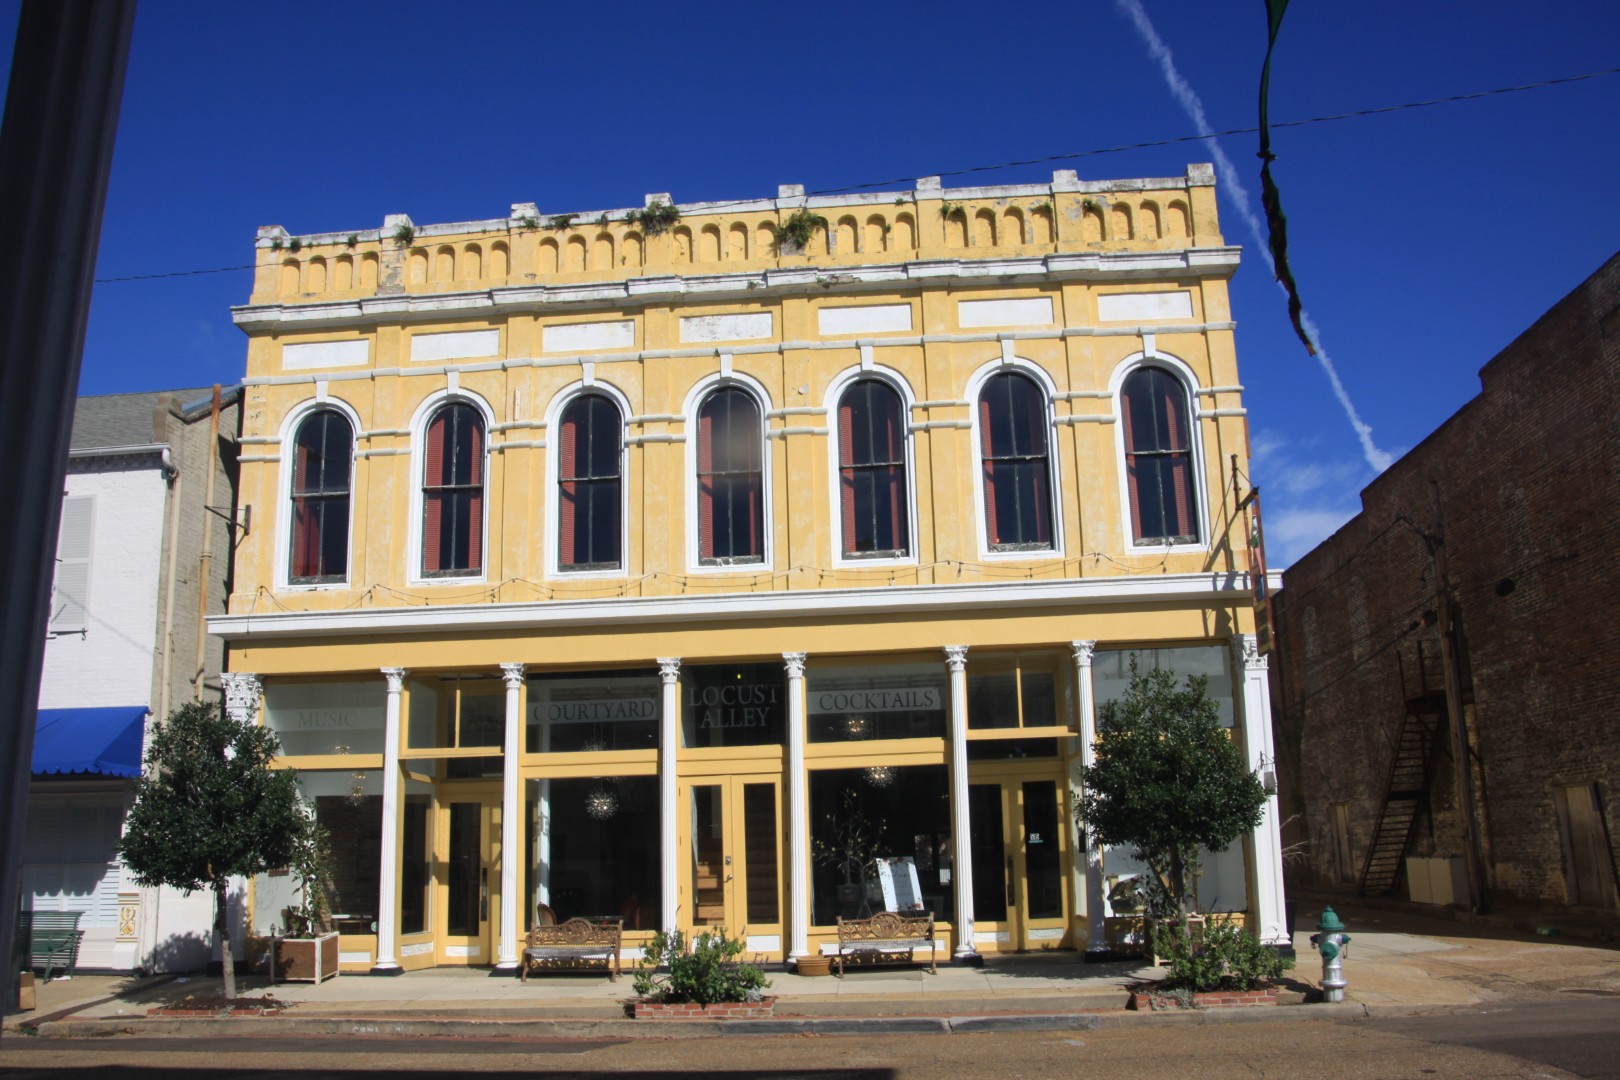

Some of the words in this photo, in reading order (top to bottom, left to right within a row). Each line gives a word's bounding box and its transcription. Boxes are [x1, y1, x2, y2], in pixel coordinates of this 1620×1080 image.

[820, 690, 934, 711] COCKTAILS
[298, 709, 357, 728] MUSIC
[533, 701, 655, 721] COURTYARD
[699, 707, 771, 729] ALLEY
